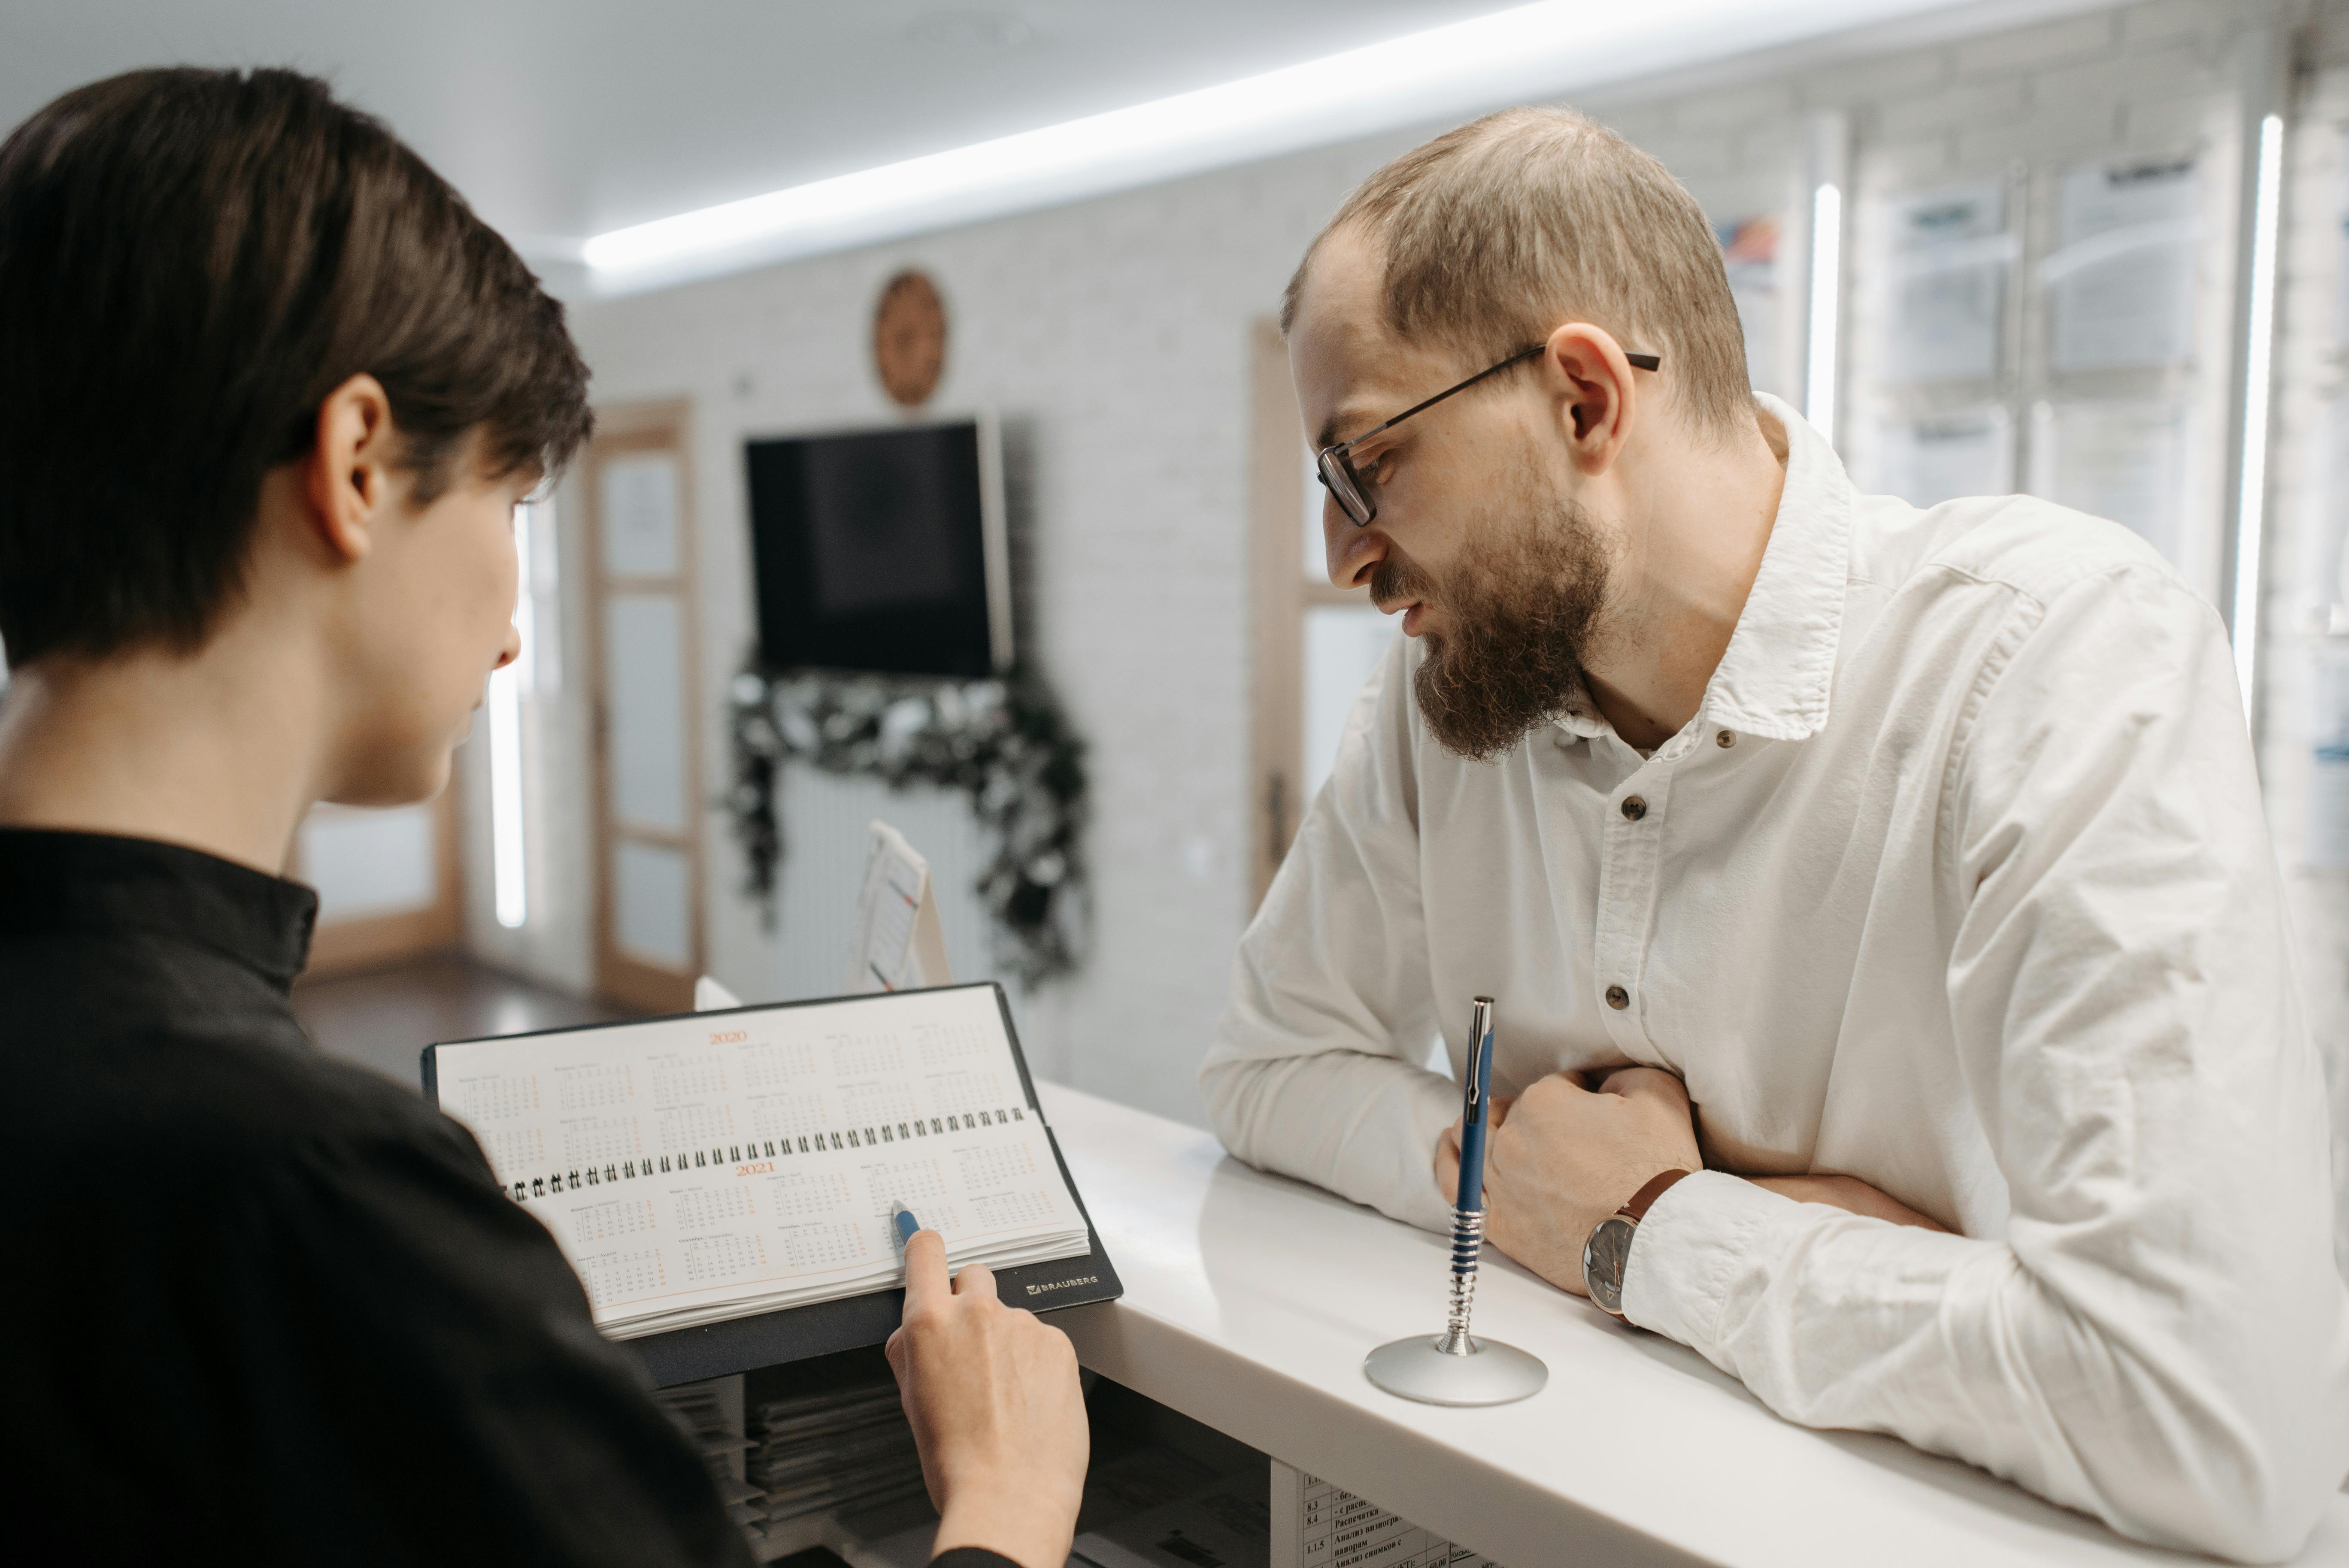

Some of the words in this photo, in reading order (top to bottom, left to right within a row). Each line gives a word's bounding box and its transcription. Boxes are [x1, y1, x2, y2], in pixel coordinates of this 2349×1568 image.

[709, 1030, 748, 1045] 2020
[735, 1162, 775, 1177] 2021
[1041, 1276, 1099, 1291] BRAUBERG
[1307, 1501, 1318, 1512] 8.3
[1307, 1514, 1318, 1525] 8.4
[1335, 1508, 1379, 1529] Распечатка
[1335, 1528, 1363, 1544] Анализ
[1307, 1540, 1324, 1554] 1.1.5
[1335, 1539, 1367, 1557] панорам
[1335, 1554, 1363, 1568] Анализ
[1365, 1541, 1396, 1559] снимков
